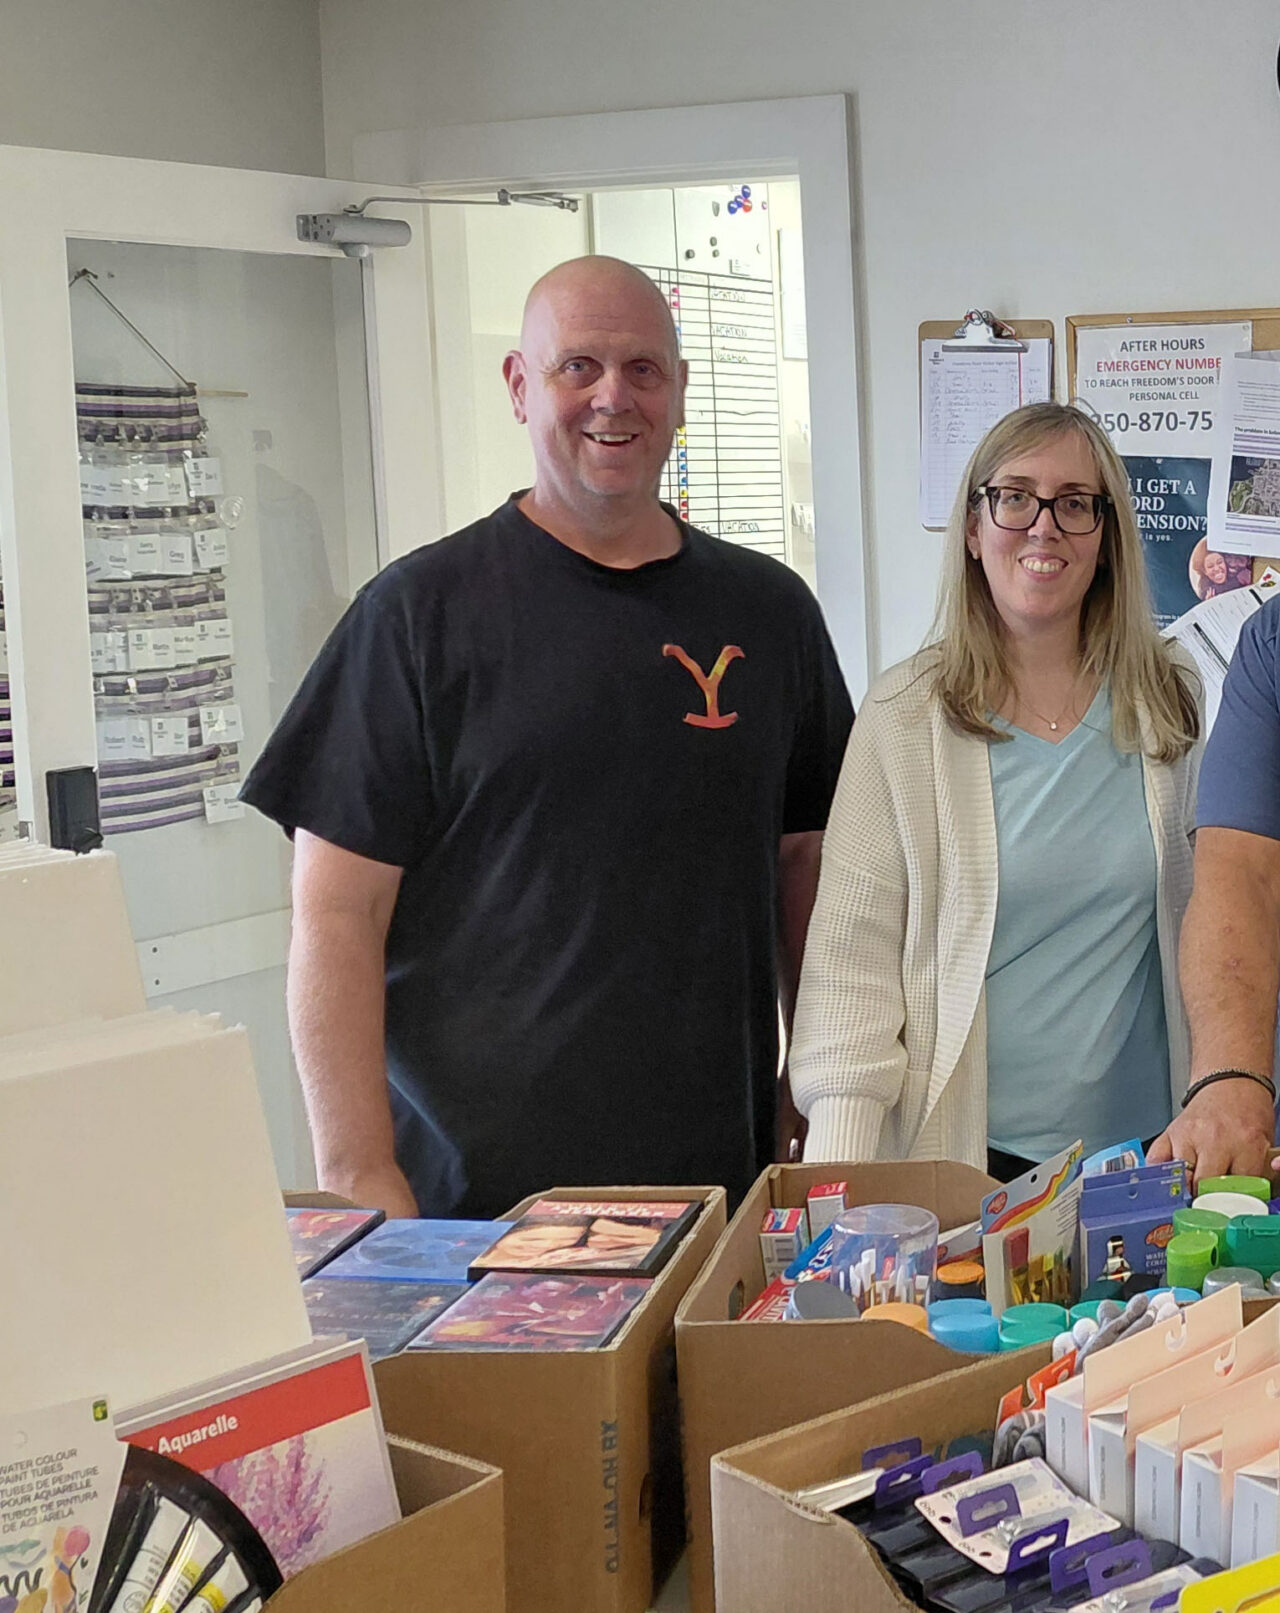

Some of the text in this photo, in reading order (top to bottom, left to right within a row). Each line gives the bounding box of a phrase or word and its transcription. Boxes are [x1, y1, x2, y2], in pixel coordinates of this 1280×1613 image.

[1120, 338, 1205, 352] AFTER HOURS
[1097, 357, 1222, 372] EMERGENCY NUMBE
[1085, 376, 1214, 388] TO REACH FREEDOM'S DOOR
[1129, 391, 1200, 401] PERSONAL CELL
[1091, 411, 1213, 433] 50-870-75
[1136, 479, 1143, 493] I
[1147, 479, 1180, 494] GET
[1184, 480, 1197, 494] A
[1130, 496, 1165, 511] ORD
[1136, 514, 1208, 531] ENSION?
[662, 643, 746, 729] Y
[158, 1414, 238, 1454] Aquarelle
[35, 1448, 77, 1466] COLOUR
[31, 1462, 63, 1478] TUBES
[0, 1465, 99, 1498] TUBES DE PEINTURE
[0, 1478, 92, 1509] POUR AQUARELLE
[2, 1490, 98, 1522] TUBOS DE PINTURA
[2, 1521, 16, 1534] DE
